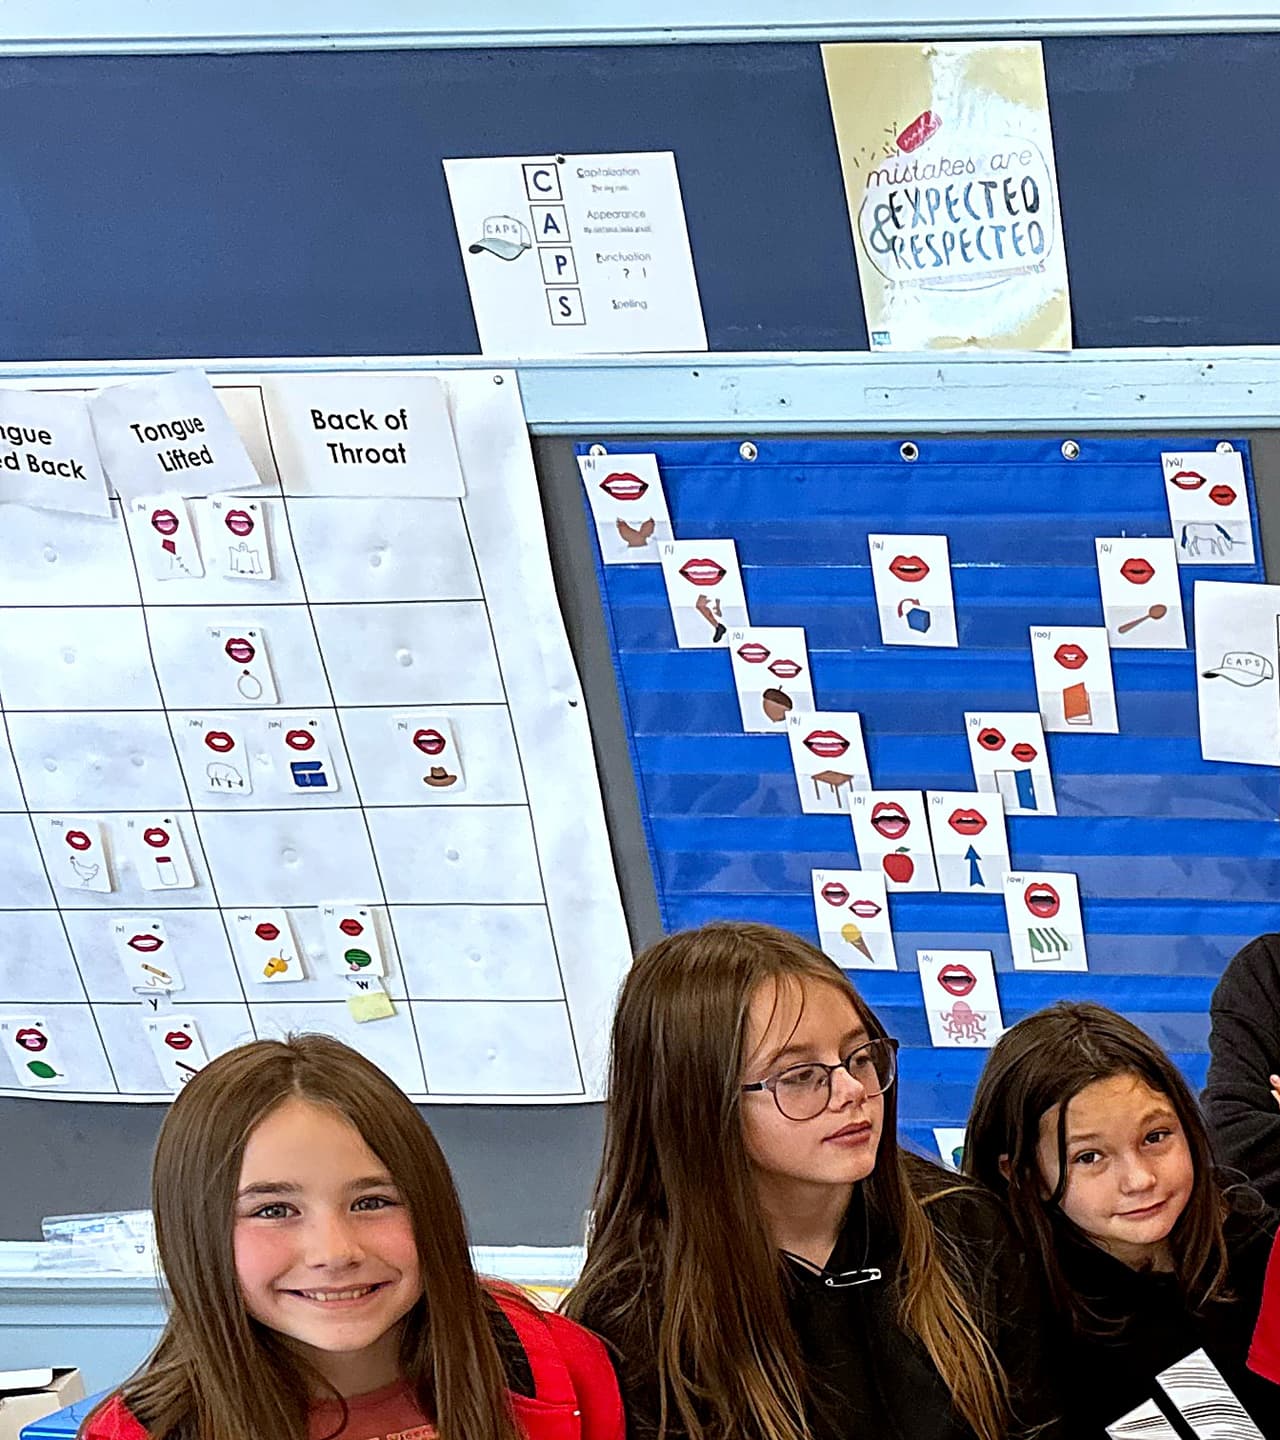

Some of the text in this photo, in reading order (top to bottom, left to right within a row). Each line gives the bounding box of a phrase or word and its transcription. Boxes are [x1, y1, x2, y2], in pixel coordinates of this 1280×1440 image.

[576, 167, 640, 179] Capitalization
[866, 149, 1034, 189] mistakes are
[533, 170, 552, 192] C
[888, 175, 1040, 230] EXPECTED
[543, 213, 561, 234] A
[587, 210, 646, 221] Appearance
[891, 220, 1045, 270] RESPECTED
[555, 255, 568, 276] P
[596, 252, 652, 263] Punctuation
[558, 296, 572, 317] S
[612, 299, 648, 311] Spelling
[130, 416, 206, 444] Tongue
[310, 408, 408, 431] Back of
[158, 443, 214, 472] Lifted
[326, 442, 407, 464] Throat
[26, 453, 87, 481] Back
